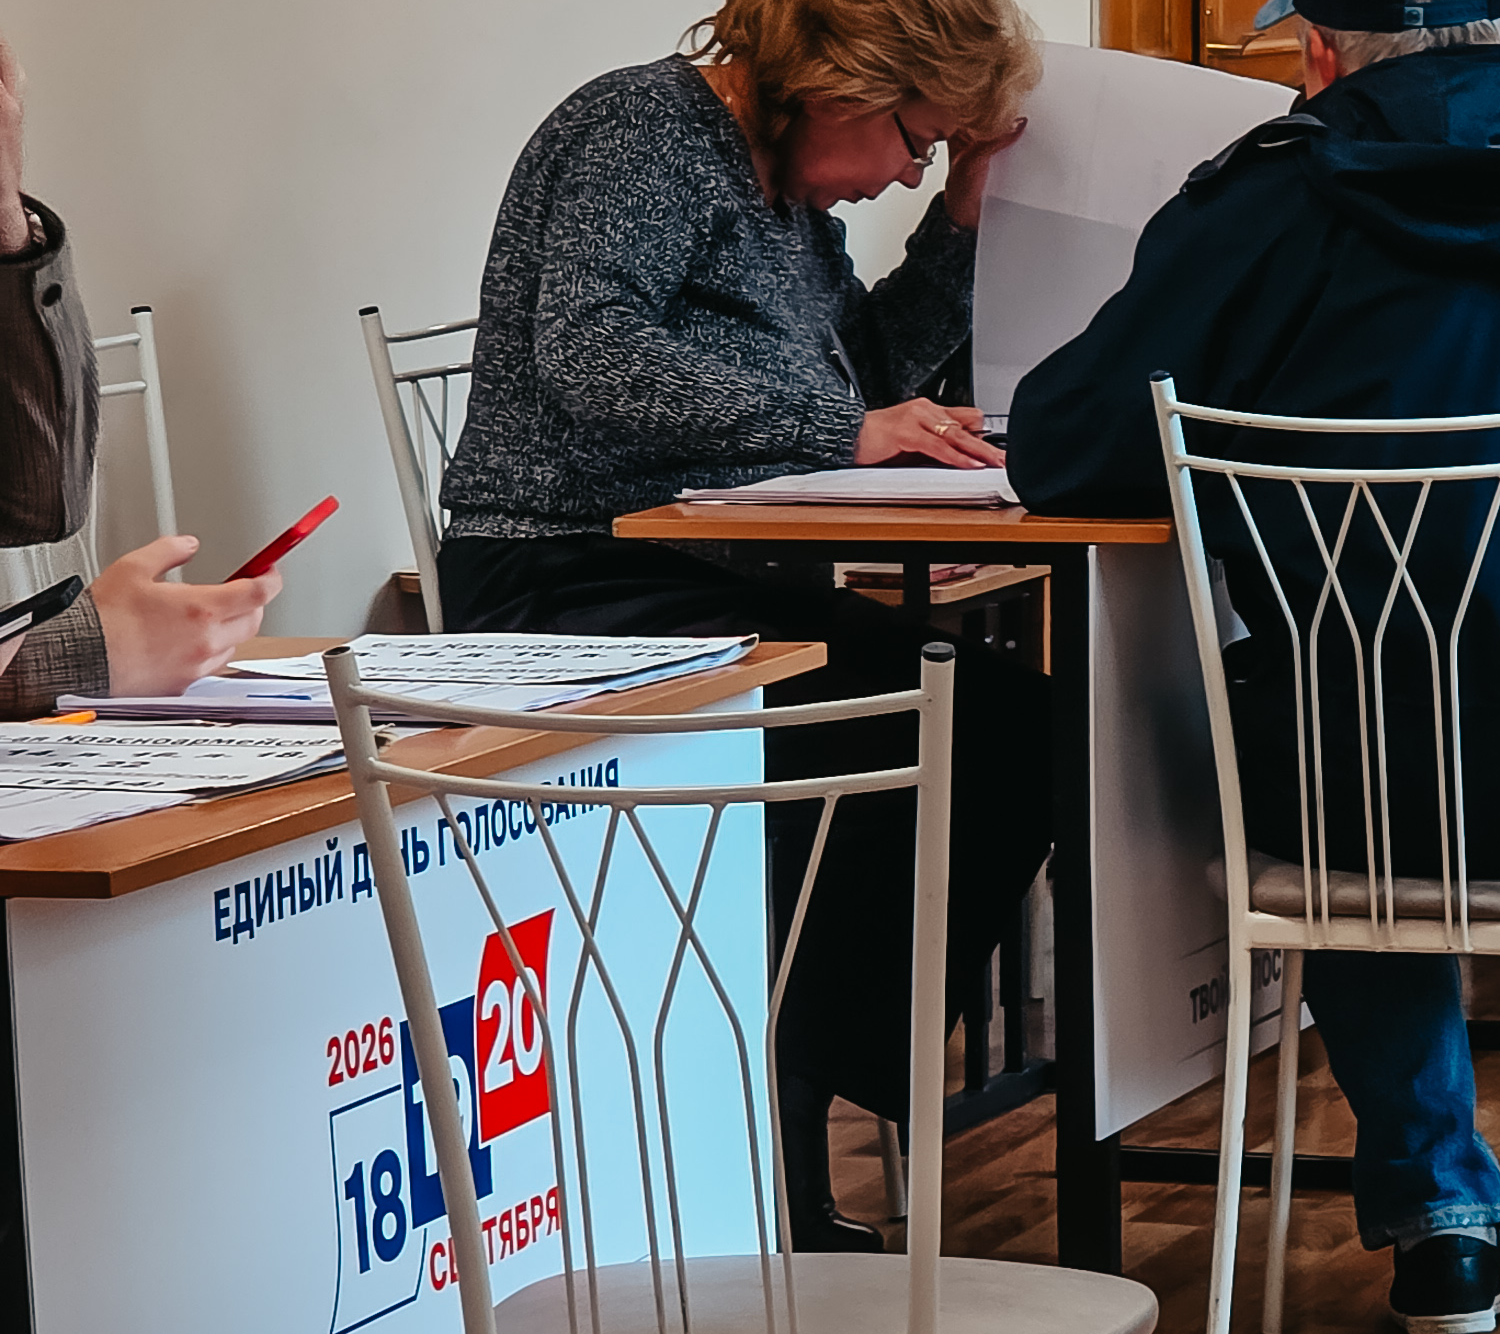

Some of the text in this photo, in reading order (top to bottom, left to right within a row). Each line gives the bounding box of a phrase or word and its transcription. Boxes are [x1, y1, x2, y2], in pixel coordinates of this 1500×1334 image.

[213, 836, 345, 945] ЕДИНЫЙ
[327, 1016, 395, 1087] 2026
[481, 966, 547, 1095] 20
[343, 1148, 408, 1275] 18
